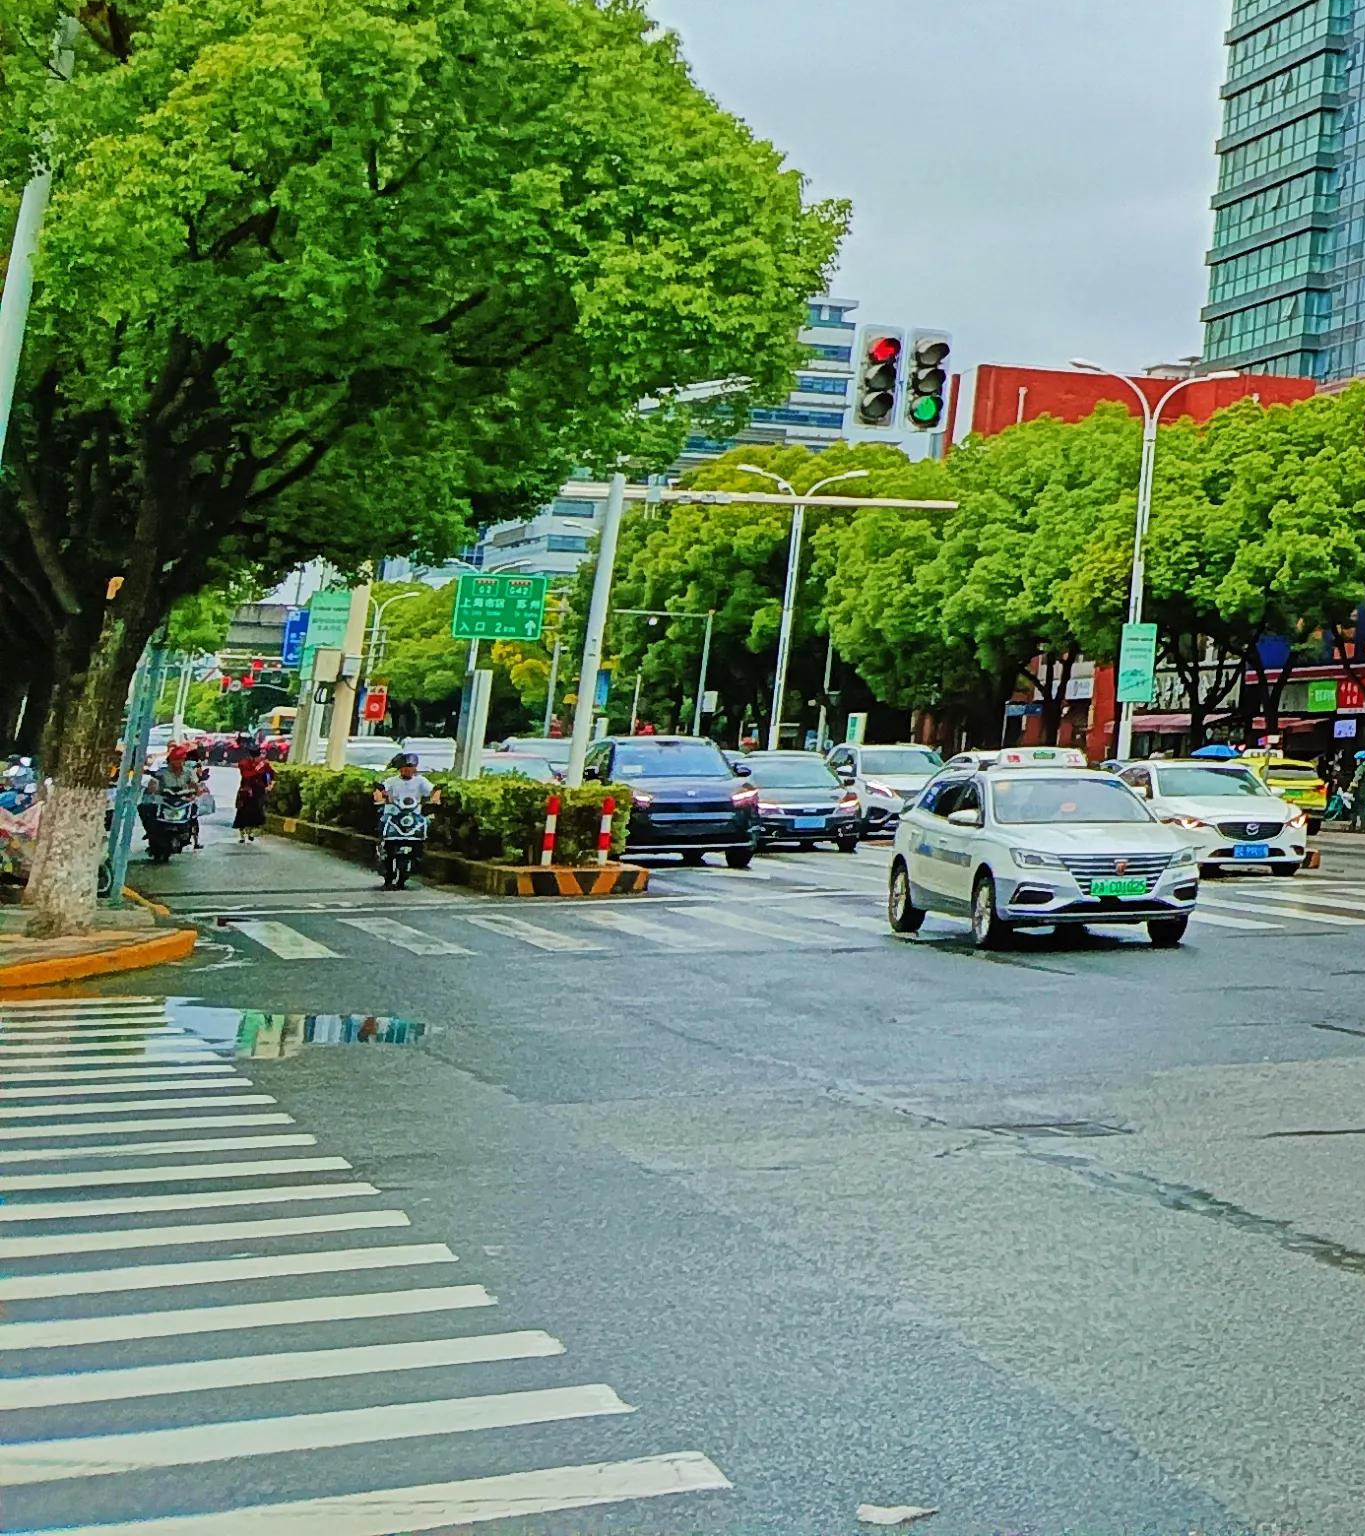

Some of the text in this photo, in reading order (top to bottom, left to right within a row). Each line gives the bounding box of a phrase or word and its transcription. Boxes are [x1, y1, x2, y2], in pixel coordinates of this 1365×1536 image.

[479, 585, 529, 595] G2 G42
[459, 621, 486, 632] 入口
